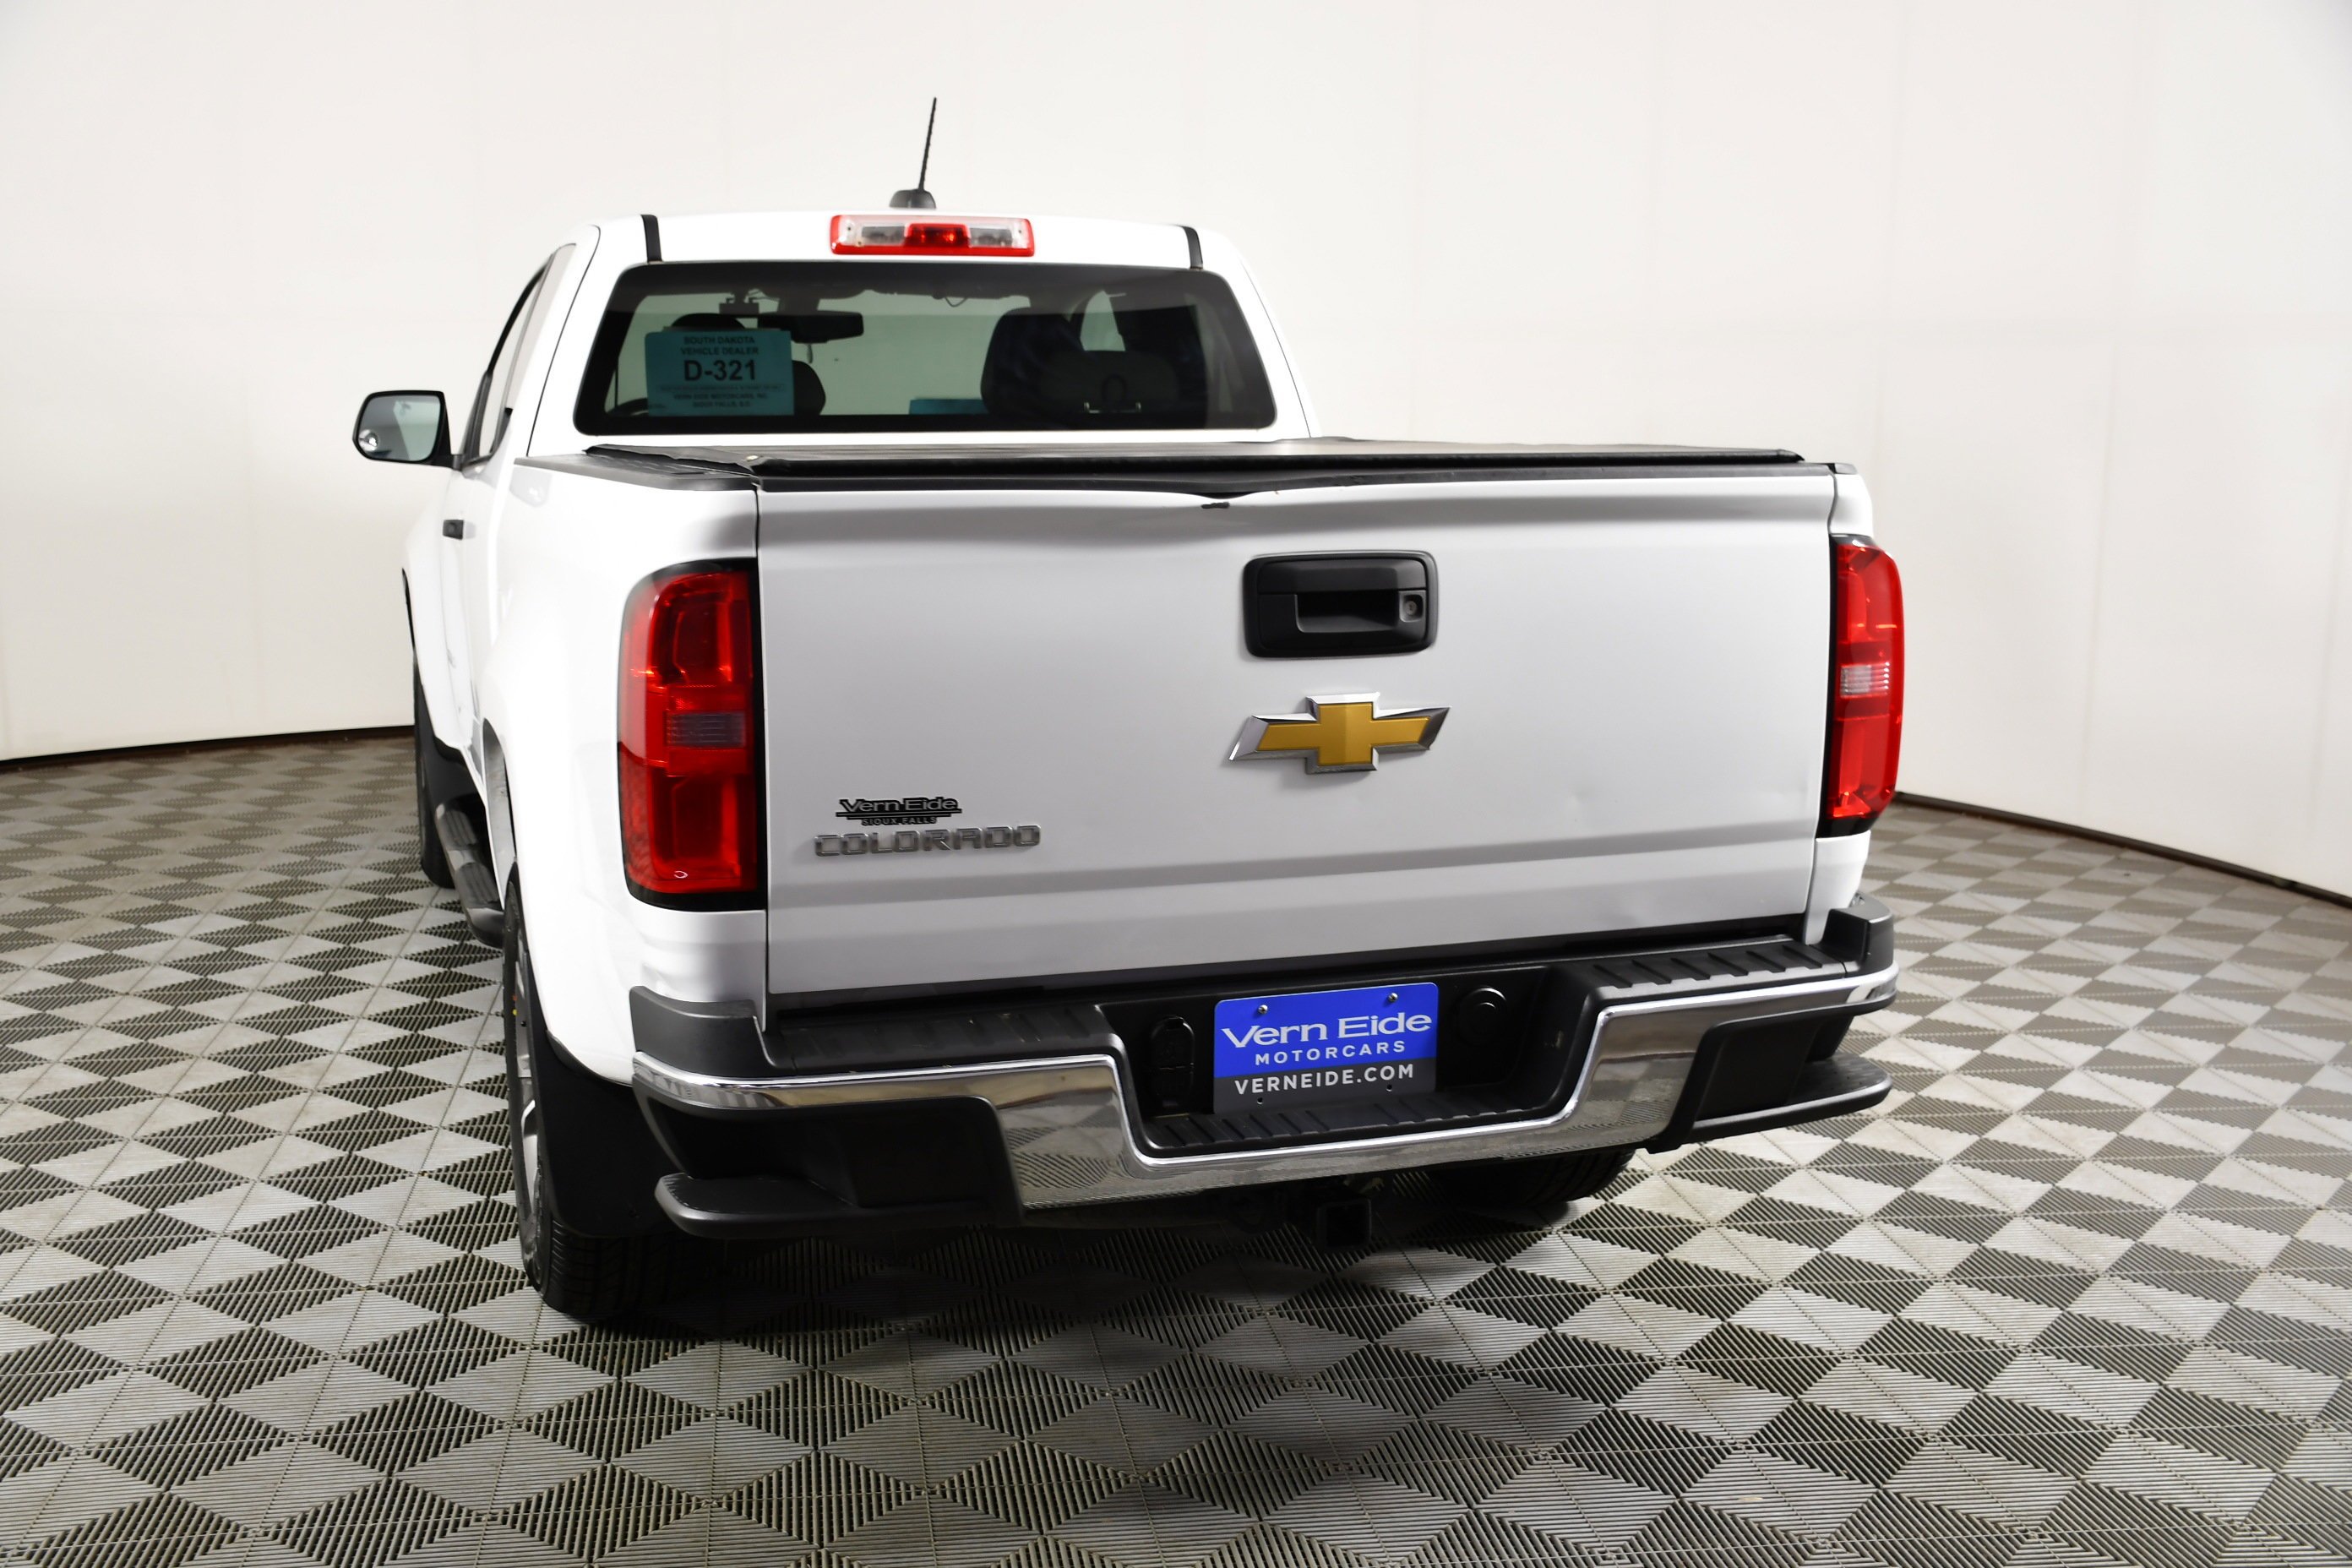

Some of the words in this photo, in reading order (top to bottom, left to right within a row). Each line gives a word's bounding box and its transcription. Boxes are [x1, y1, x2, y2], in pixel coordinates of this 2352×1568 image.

[683, 336, 716, 345] SOUTH
[717, 335, 755, 344] DAKOTA
[722, 346, 759, 355] DEALER
[683, 359, 756, 381] D-321
[841, 799, 900, 813] Vern
[905, 798, 958, 811] Eide
[814, 825, 1042, 857] COLORADO
[1222, 1023, 1327, 1048] Vern
[1337, 1012, 1432, 1038] Eide
[1255, 1040, 1406, 1065] MOTORCARS
[1234, 1064, 1414, 1094] VERNEIDE.COM
